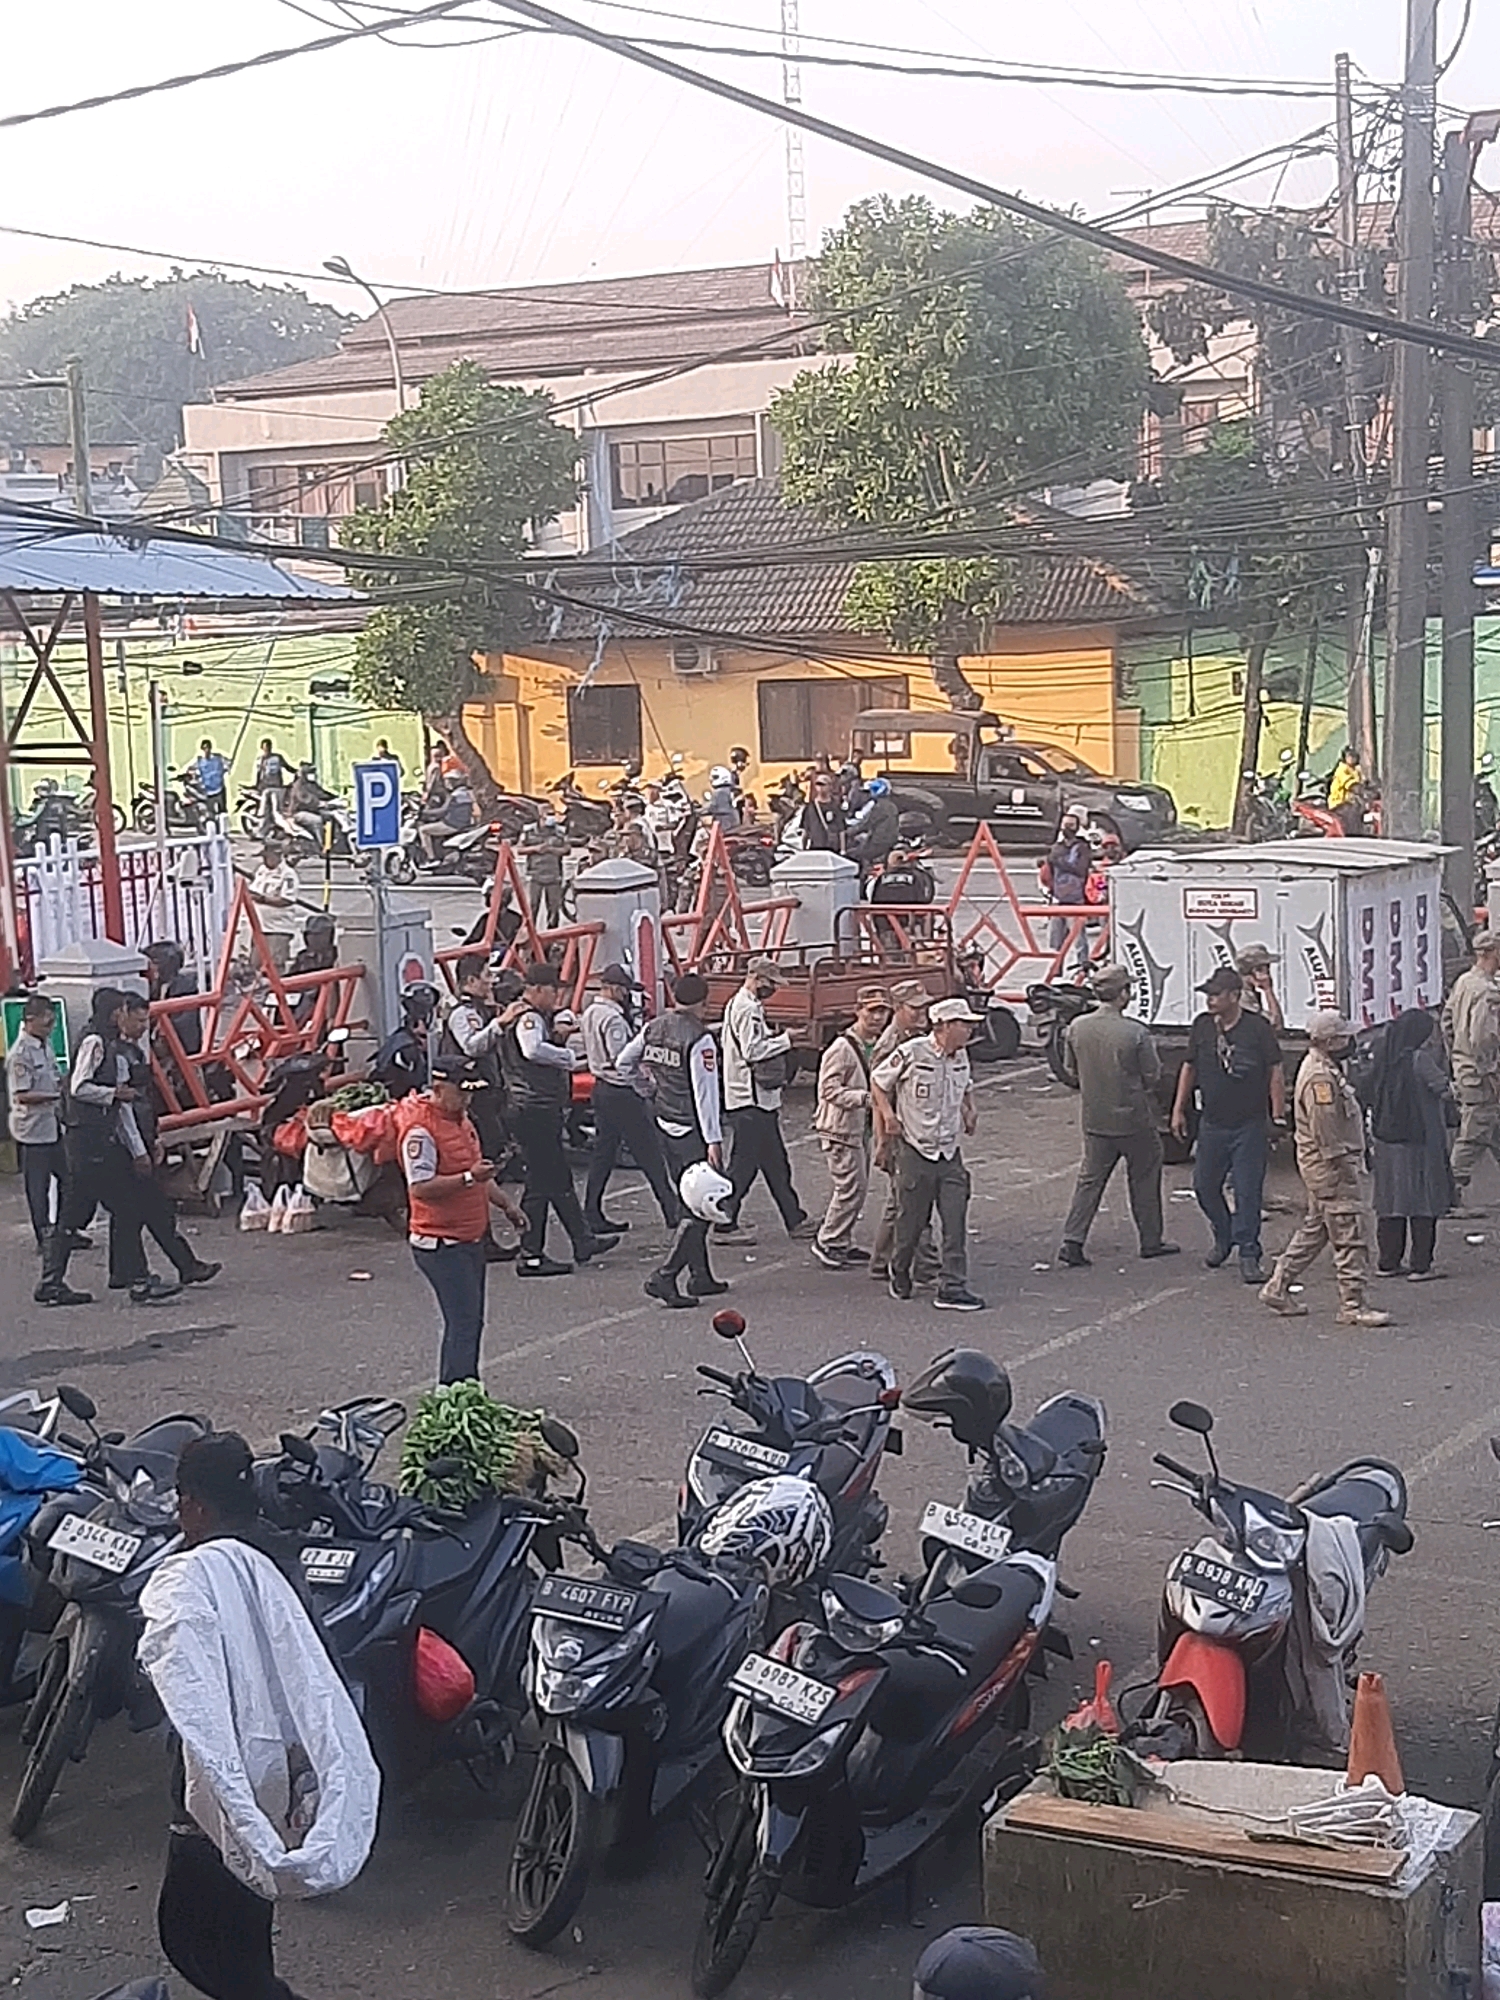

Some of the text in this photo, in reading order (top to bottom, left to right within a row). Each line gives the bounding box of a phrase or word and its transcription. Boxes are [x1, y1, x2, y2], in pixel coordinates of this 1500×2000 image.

[361, 771, 393, 836] P
[1126, 943, 1150, 1018] ALUSHARK
[62, 1518, 74, 1531] B
[927, 1504, 937, 1517] B
[542, 1581, 632, 1611] B 4607 FYP
[744, 1657, 831, 1705] B 6987 KZS
